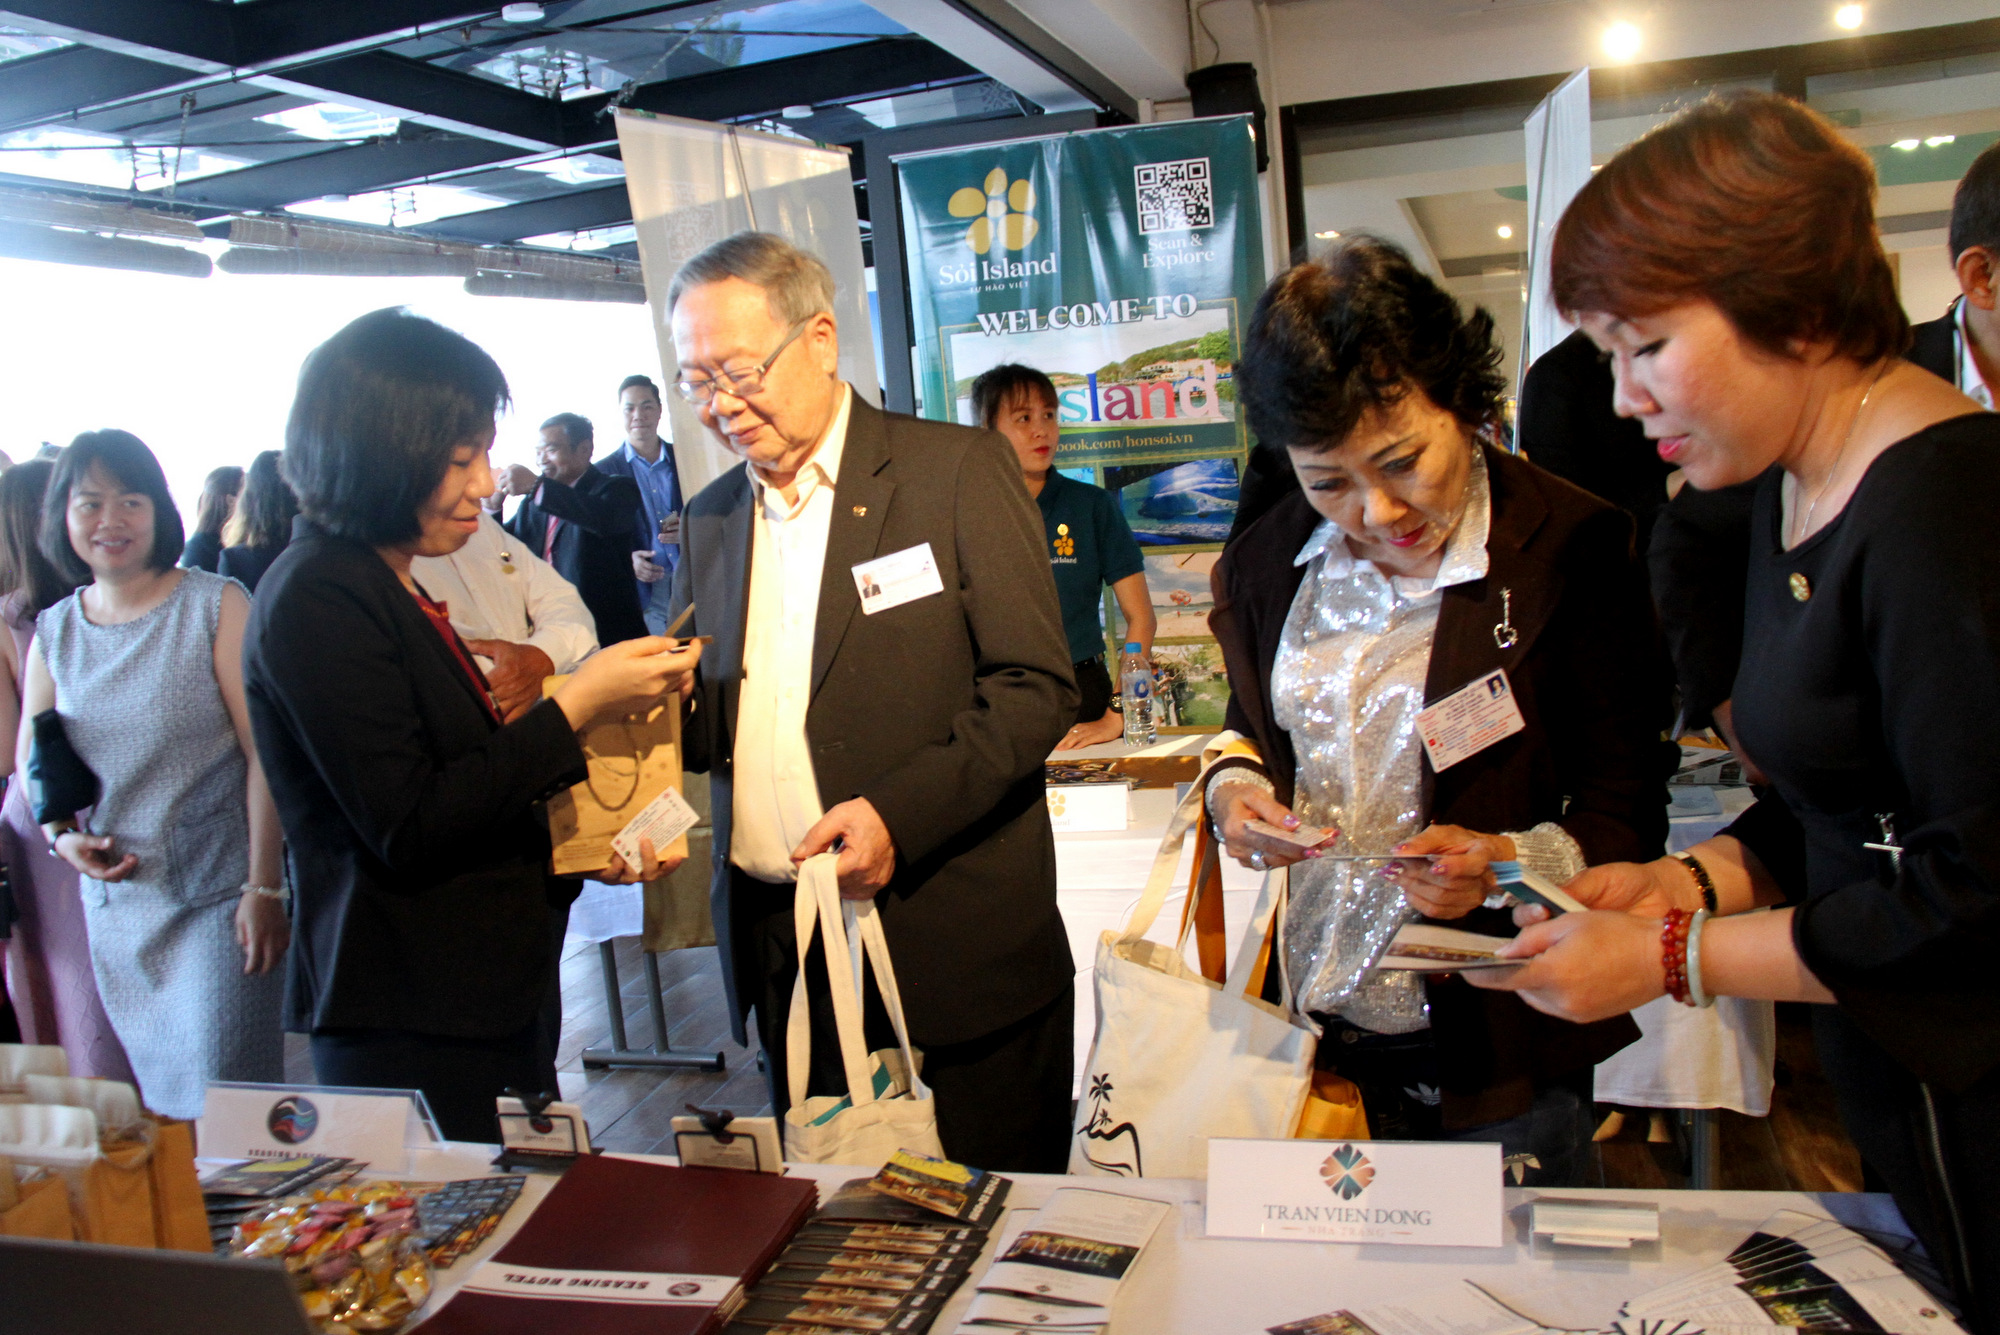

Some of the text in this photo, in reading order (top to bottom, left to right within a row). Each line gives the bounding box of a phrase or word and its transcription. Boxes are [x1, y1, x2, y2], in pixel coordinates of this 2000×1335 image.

[1148, 233, 1203, 251] Scan &
[981, 252, 1058, 281] Island
[1142, 249, 1215, 270] Explore
[976, 293, 1198, 337] WELCOME TO
[1059, 358, 1227, 422] sland
[1263, 1204, 1432, 1226] TRAN VIEN DONG
[503, 1272, 564, 1286] HOTEL
[566, 1277, 650, 1290] SEASING
